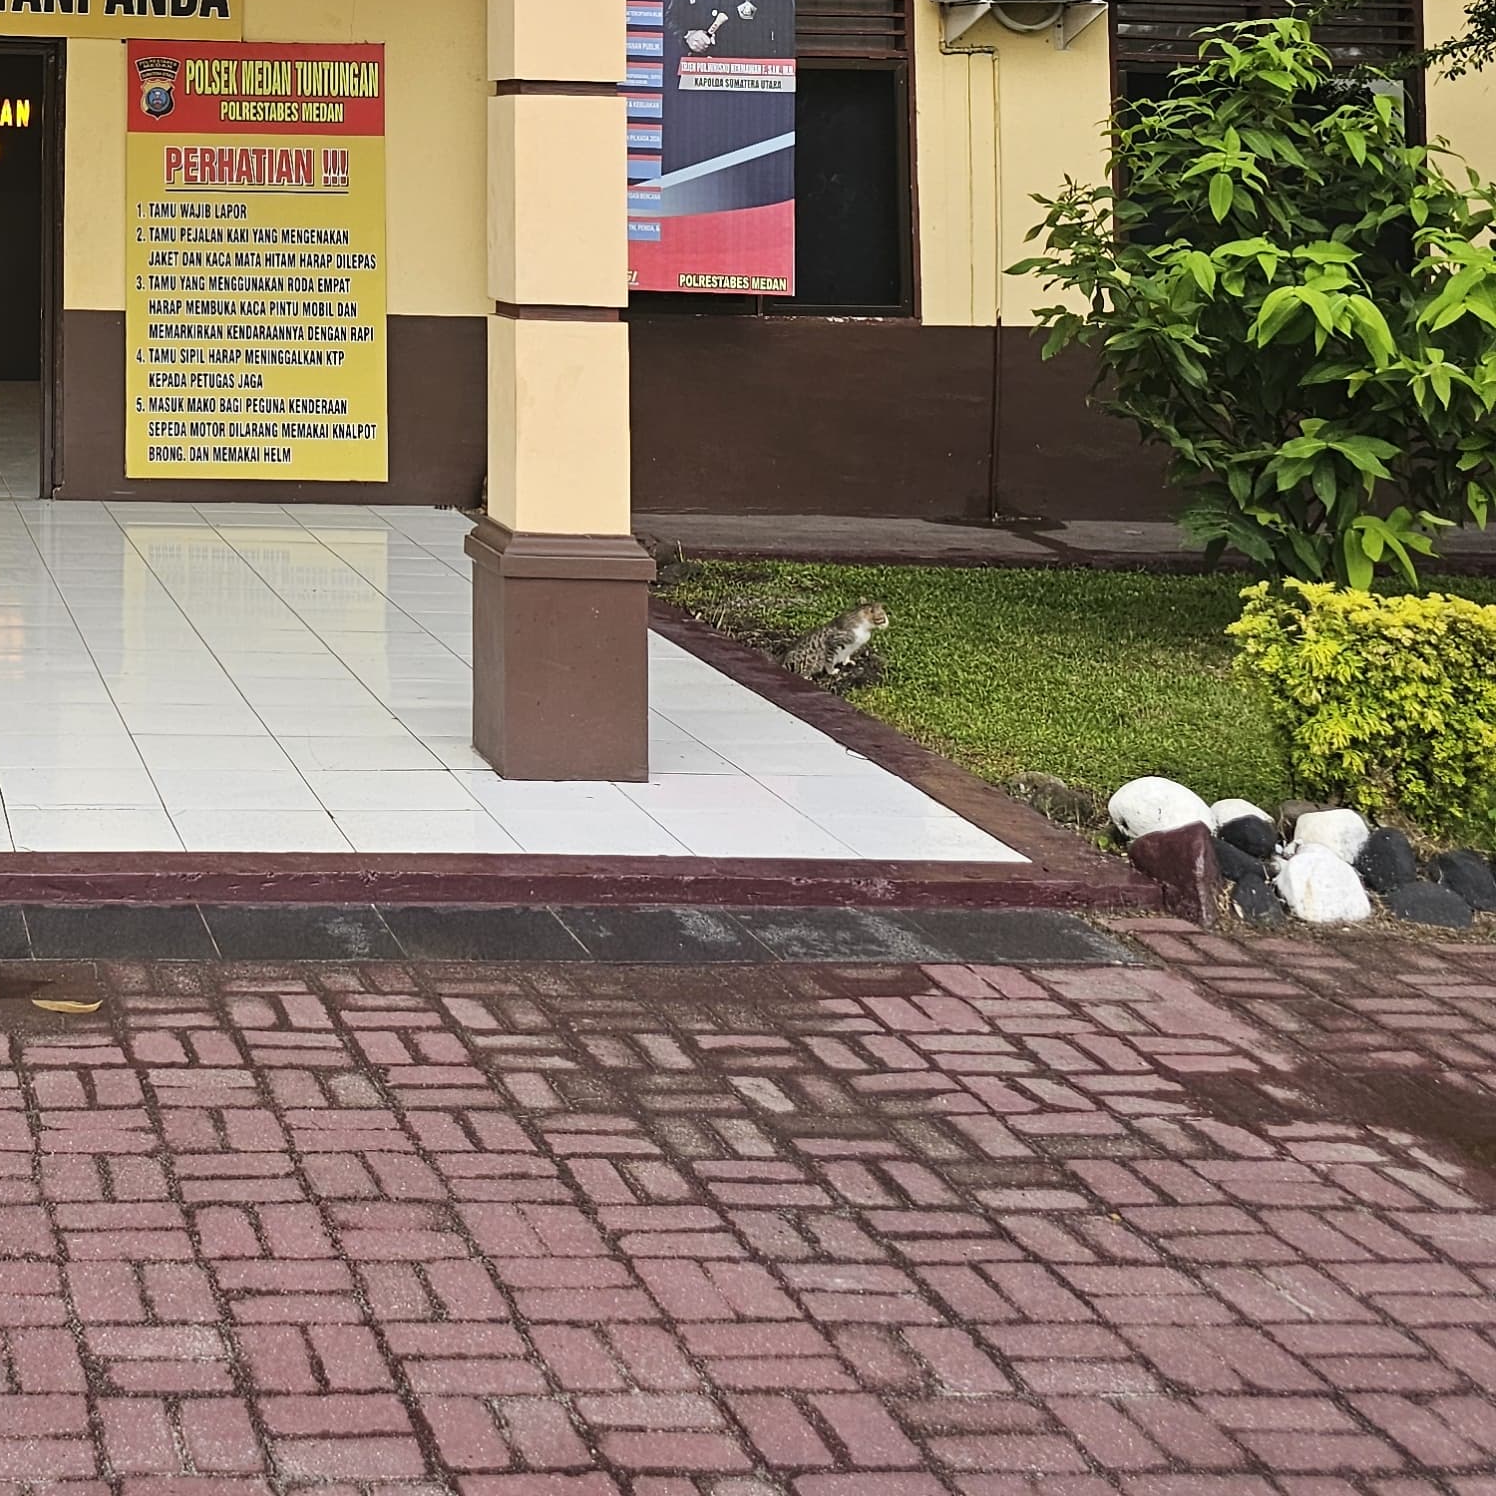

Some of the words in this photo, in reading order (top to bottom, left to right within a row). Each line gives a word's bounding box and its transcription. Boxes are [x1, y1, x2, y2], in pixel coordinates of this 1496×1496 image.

[185, 59, 239, 96] POLSEK
[241, 60, 292, 97] MEDAN
[295, 61, 379, 98] TUNTUNGAN
[220, 101, 298, 121] POLRESTABES
[301, 102, 344, 122] MEDAN
[165, 146, 314, 186] PERHATIAN
[322, 148, 349, 187] !!!
[137, 203, 145, 218] 1.
[149, 203, 176, 218] TAMU
[180, 203, 211, 218] WAJIB
[215, 203, 247, 218] LAPOR
[137, 228, 145, 242] 2.
[149, 228, 176, 242] TAMU
[180, 228, 223, 242] PEJALAN
[227, 228, 248, 243] KAKI
[253, 229, 277, 243] YANG
[281, 229, 349, 244] MENGENAKAN
[148, 252, 178, 266] JAKET
[182, 252, 201, 267] DAN
[205, 252, 231, 267] KACA
[235, 253, 261, 267] MATA
[265, 253, 295, 268] HITAM
[299, 253, 332, 268] HARAP
[336, 254, 376, 268] DILEPAS
[136, 275, 145, 290] 3.
[149, 276, 176, 290] TAMU
[180, 276, 204, 291] YANG
[209, 276, 283, 292] MENGGUNAKAN
[287, 277, 314, 292] RODA
[318, 277, 350, 292] EMPAT
[679, 273, 749, 289] POLRESTABES
[751, 277, 787, 291] MEDAN
[149, 300, 181, 315] HARAP
[186, 301, 236, 316] MEMBUKA
[240, 301, 266, 316] KACA
[269, 301, 298, 316] PINTU
[303, 302, 334, 317] MOBIL
[337, 302, 357, 317] DAN
[149, 324, 223, 340] MEMARKIRKAN
[227, 325, 304, 341] KENDARAANNYA
[307, 326, 346, 341] DENGAN
[350, 326, 374, 341] RAPI
[136, 348, 145, 363] 4.
[149, 349, 176, 363] TAMU
[180, 349, 205, 364] SIPIL
[209, 349, 241, 364] HARAP
[245, 350, 322, 365] MENINGGALKAN
[326, 350, 345, 365] KTP
[149, 373, 186, 388] KEPADA
[190, 373, 234, 389] PETUGAS
[238, 374, 263, 389] JAGA
[136, 397, 145, 412] 5.
[149, 398, 184, 412] MASUK
[187, 398, 215, 413] MAKO
[219, 398, 241, 413] BAGI
[246, 398, 285, 413] PEGUNA
[289, 399, 347, 414] KENDERAAN
[149, 423, 186, 437] SEPEDA
[190, 423, 225, 437] MOTOR
[229, 423, 278, 438] DILARANG
[282, 424, 328, 438] MEMAKAI
[332, 424, 376, 439] KNALPOT
[149, 447, 186, 461] BRONG.
[189, 447, 209, 461] DAN
[213, 447, 259, 462] MEMAKAI
[264, 447, 291, 462] HELM
